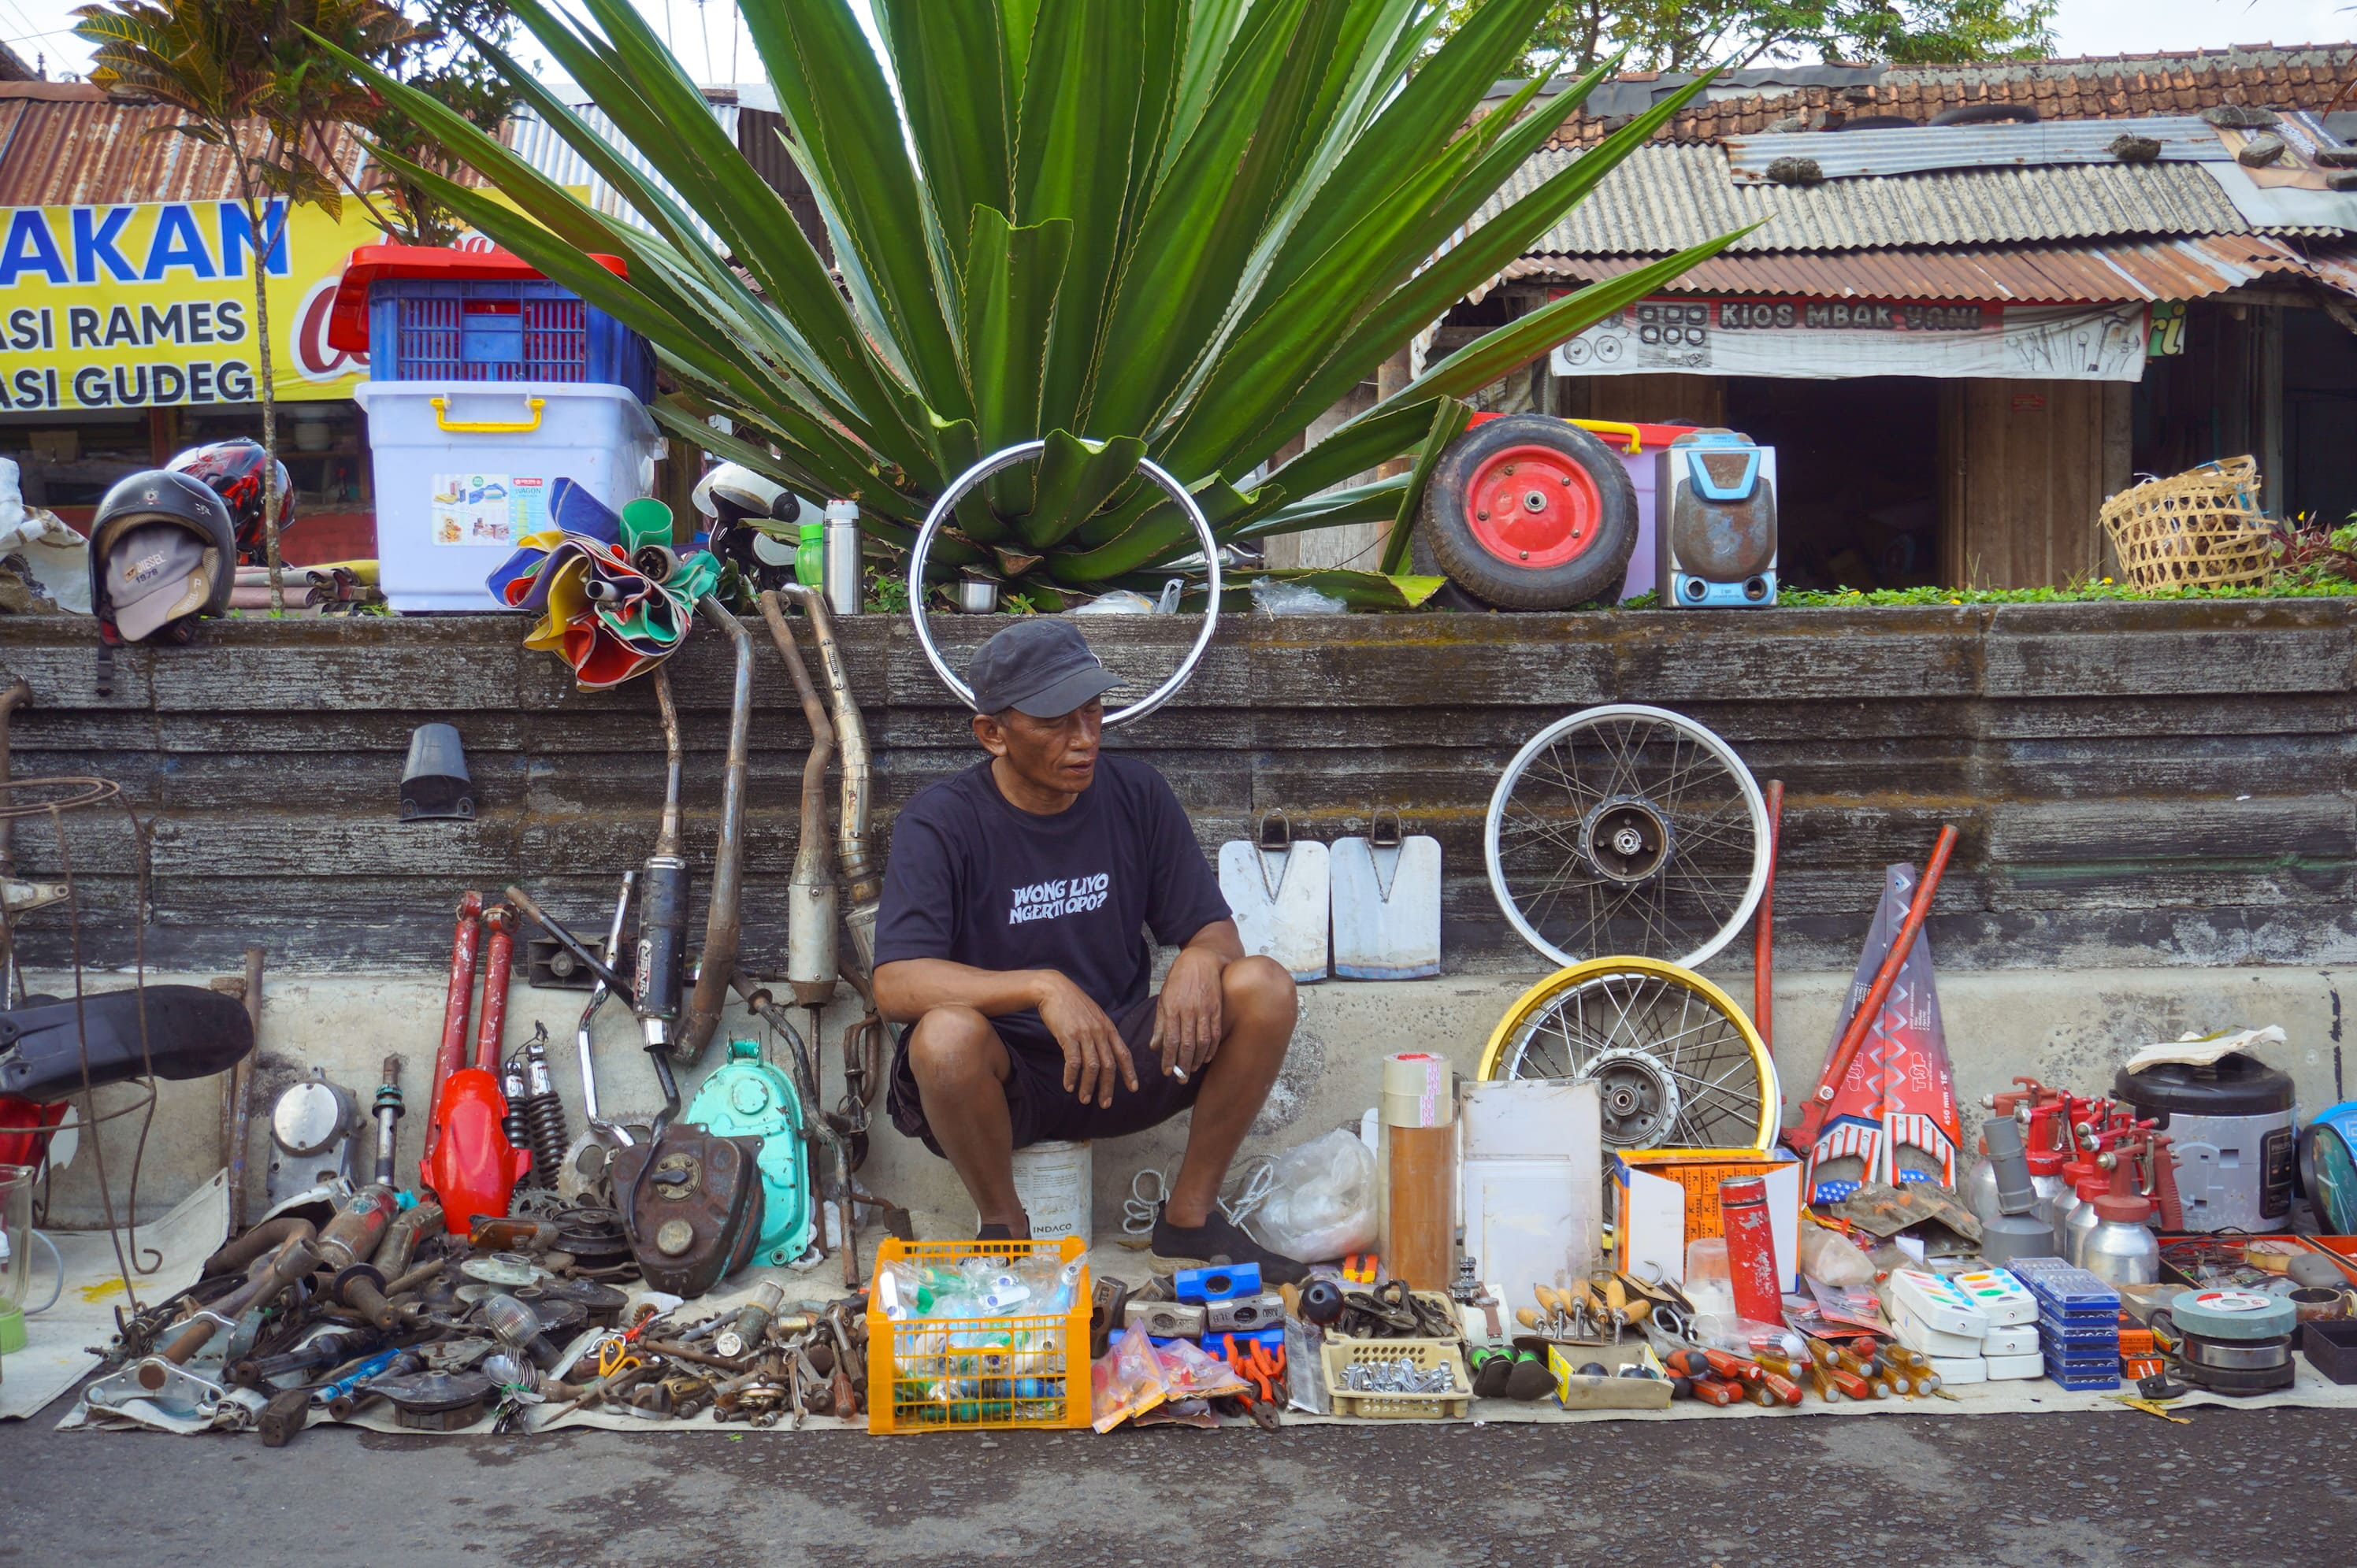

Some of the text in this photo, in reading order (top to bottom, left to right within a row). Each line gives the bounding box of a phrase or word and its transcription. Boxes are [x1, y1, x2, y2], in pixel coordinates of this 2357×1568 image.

[0, 307, 54, 350] SI
[69, 300, 246, 348] RAMES
[1806, 303, 1893, 328] MBAK
[74, 361, 254, 407] GUDEG
[136, 554, 167, 573] DIESEL
[135, 568, 158, 584] 1978
[1011, 880, 1067, 907] WONG
[1009, 891, 1108, 925] NGERTI OPO?
[1942, 1092, 1951, 1106] mm
[1942, 1106, 1951, 1125] 450
[1033, 1223, 1072, 1233] INDACO
